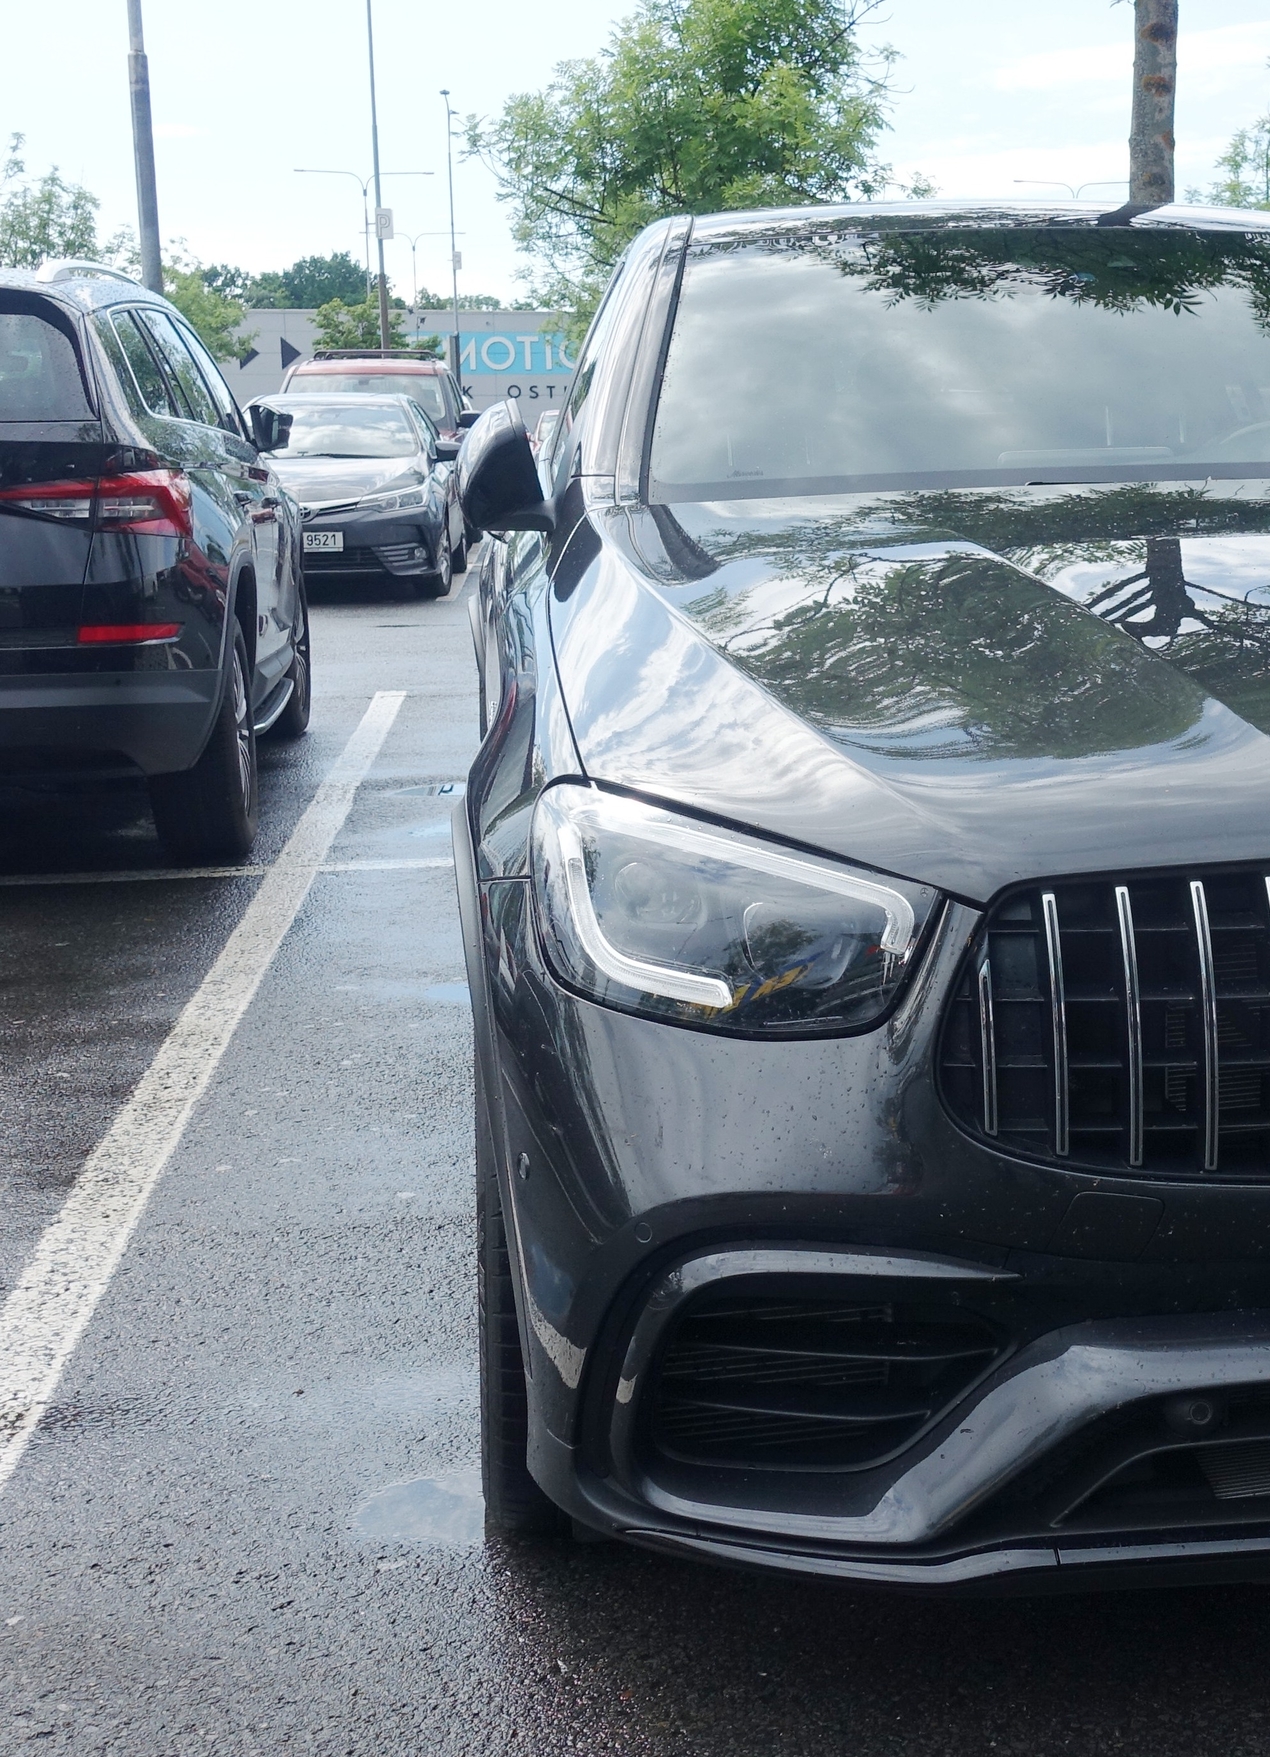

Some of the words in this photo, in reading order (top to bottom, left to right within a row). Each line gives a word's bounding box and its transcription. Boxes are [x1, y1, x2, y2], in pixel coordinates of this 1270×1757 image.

[377, 214, 390, 237] P
[507, 385, 567, 399] OST
[306, 534, 336, 546] 9521
